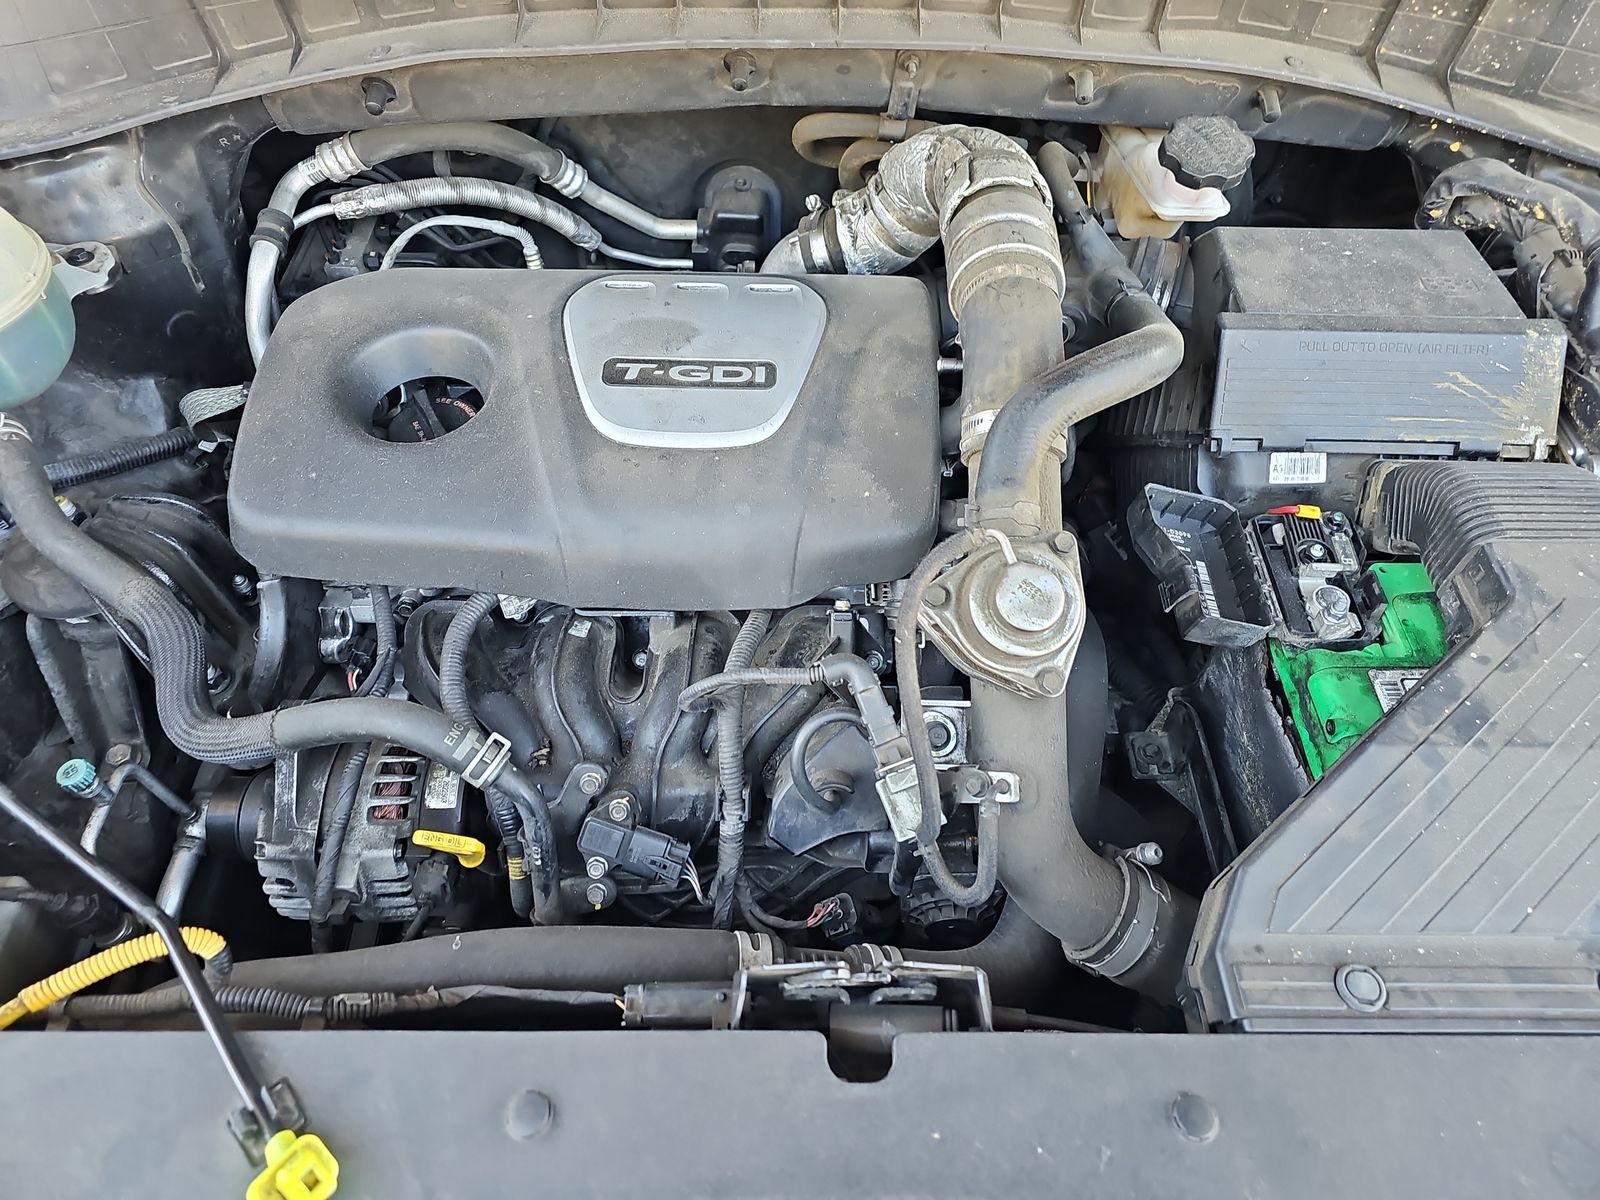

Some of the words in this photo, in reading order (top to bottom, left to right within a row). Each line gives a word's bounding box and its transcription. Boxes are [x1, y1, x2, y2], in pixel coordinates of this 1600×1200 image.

[1299, 340, 1329, 352] PULL
[1332, 341, 1358, 352] OUT
[1360, 342, 1376, 353] TO
[1379, 342, 1412, 353] OPEN
[615, 362, 766, 383] T-GDI
[435, 397, 452, 405] SEE
[443, 722, 464, 746] ENG
